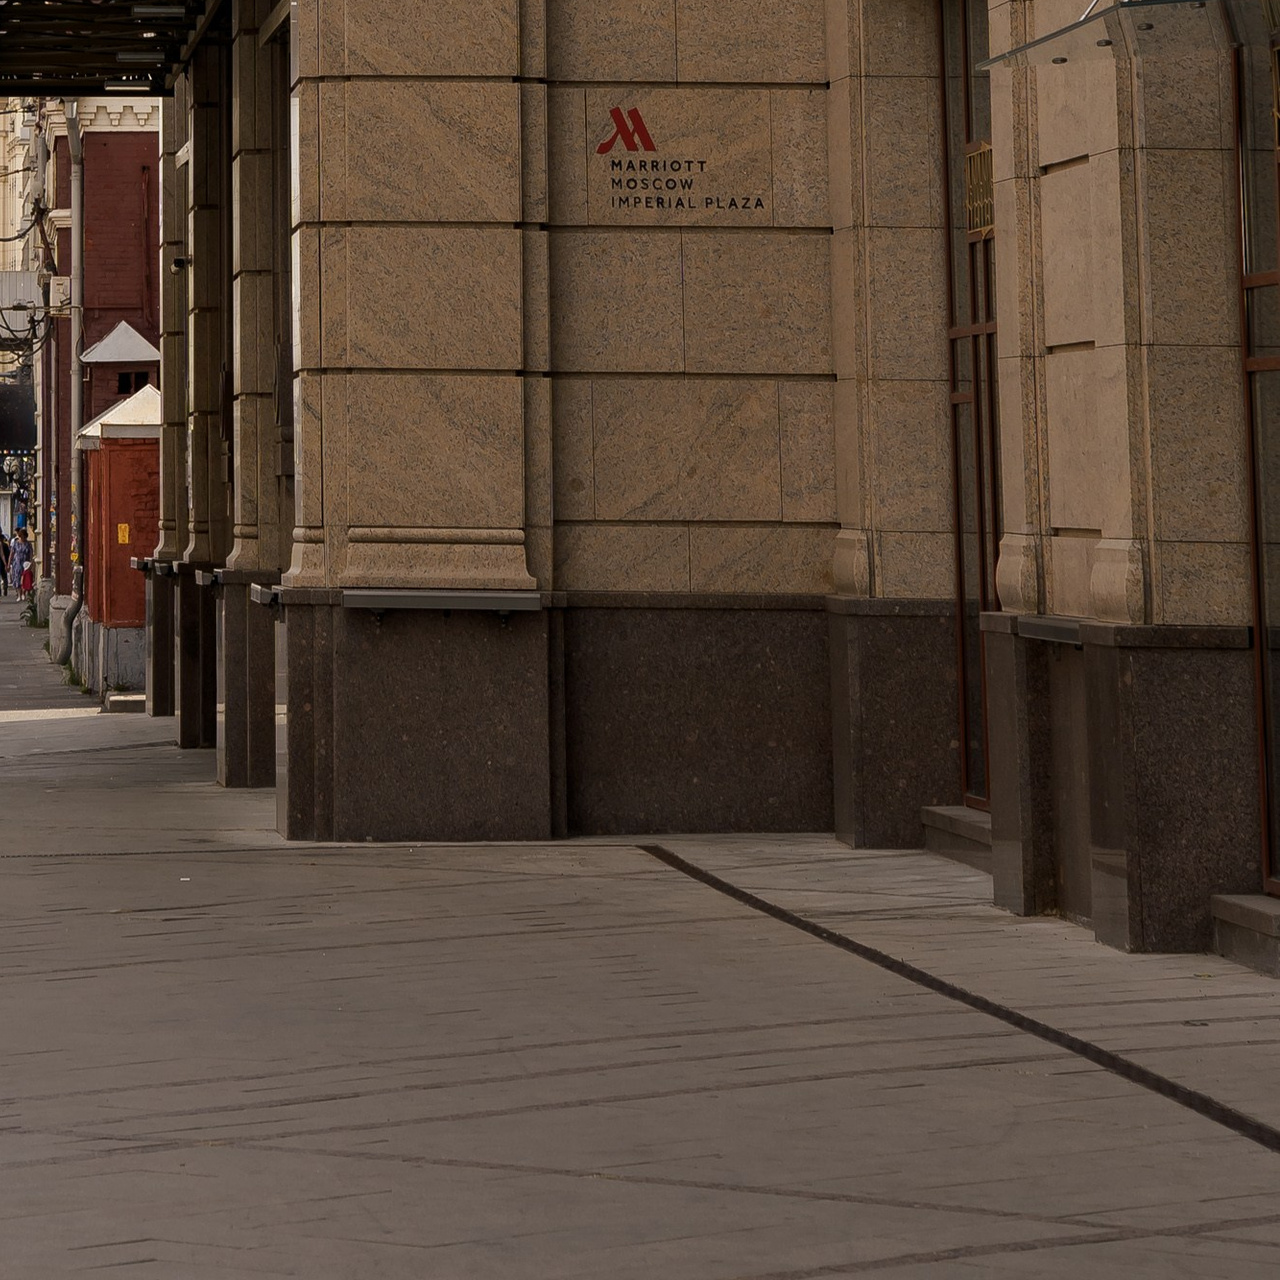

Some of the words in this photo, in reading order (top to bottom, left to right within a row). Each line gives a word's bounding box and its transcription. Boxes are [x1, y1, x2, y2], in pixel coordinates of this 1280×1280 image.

[611, 160, 707, 172] MARRIOTT
[611, 178, 694, 190] MOSCOW
[611, 196, 696, 209] IMPERIAL
[705, 197, 764, 210] PLAZA
